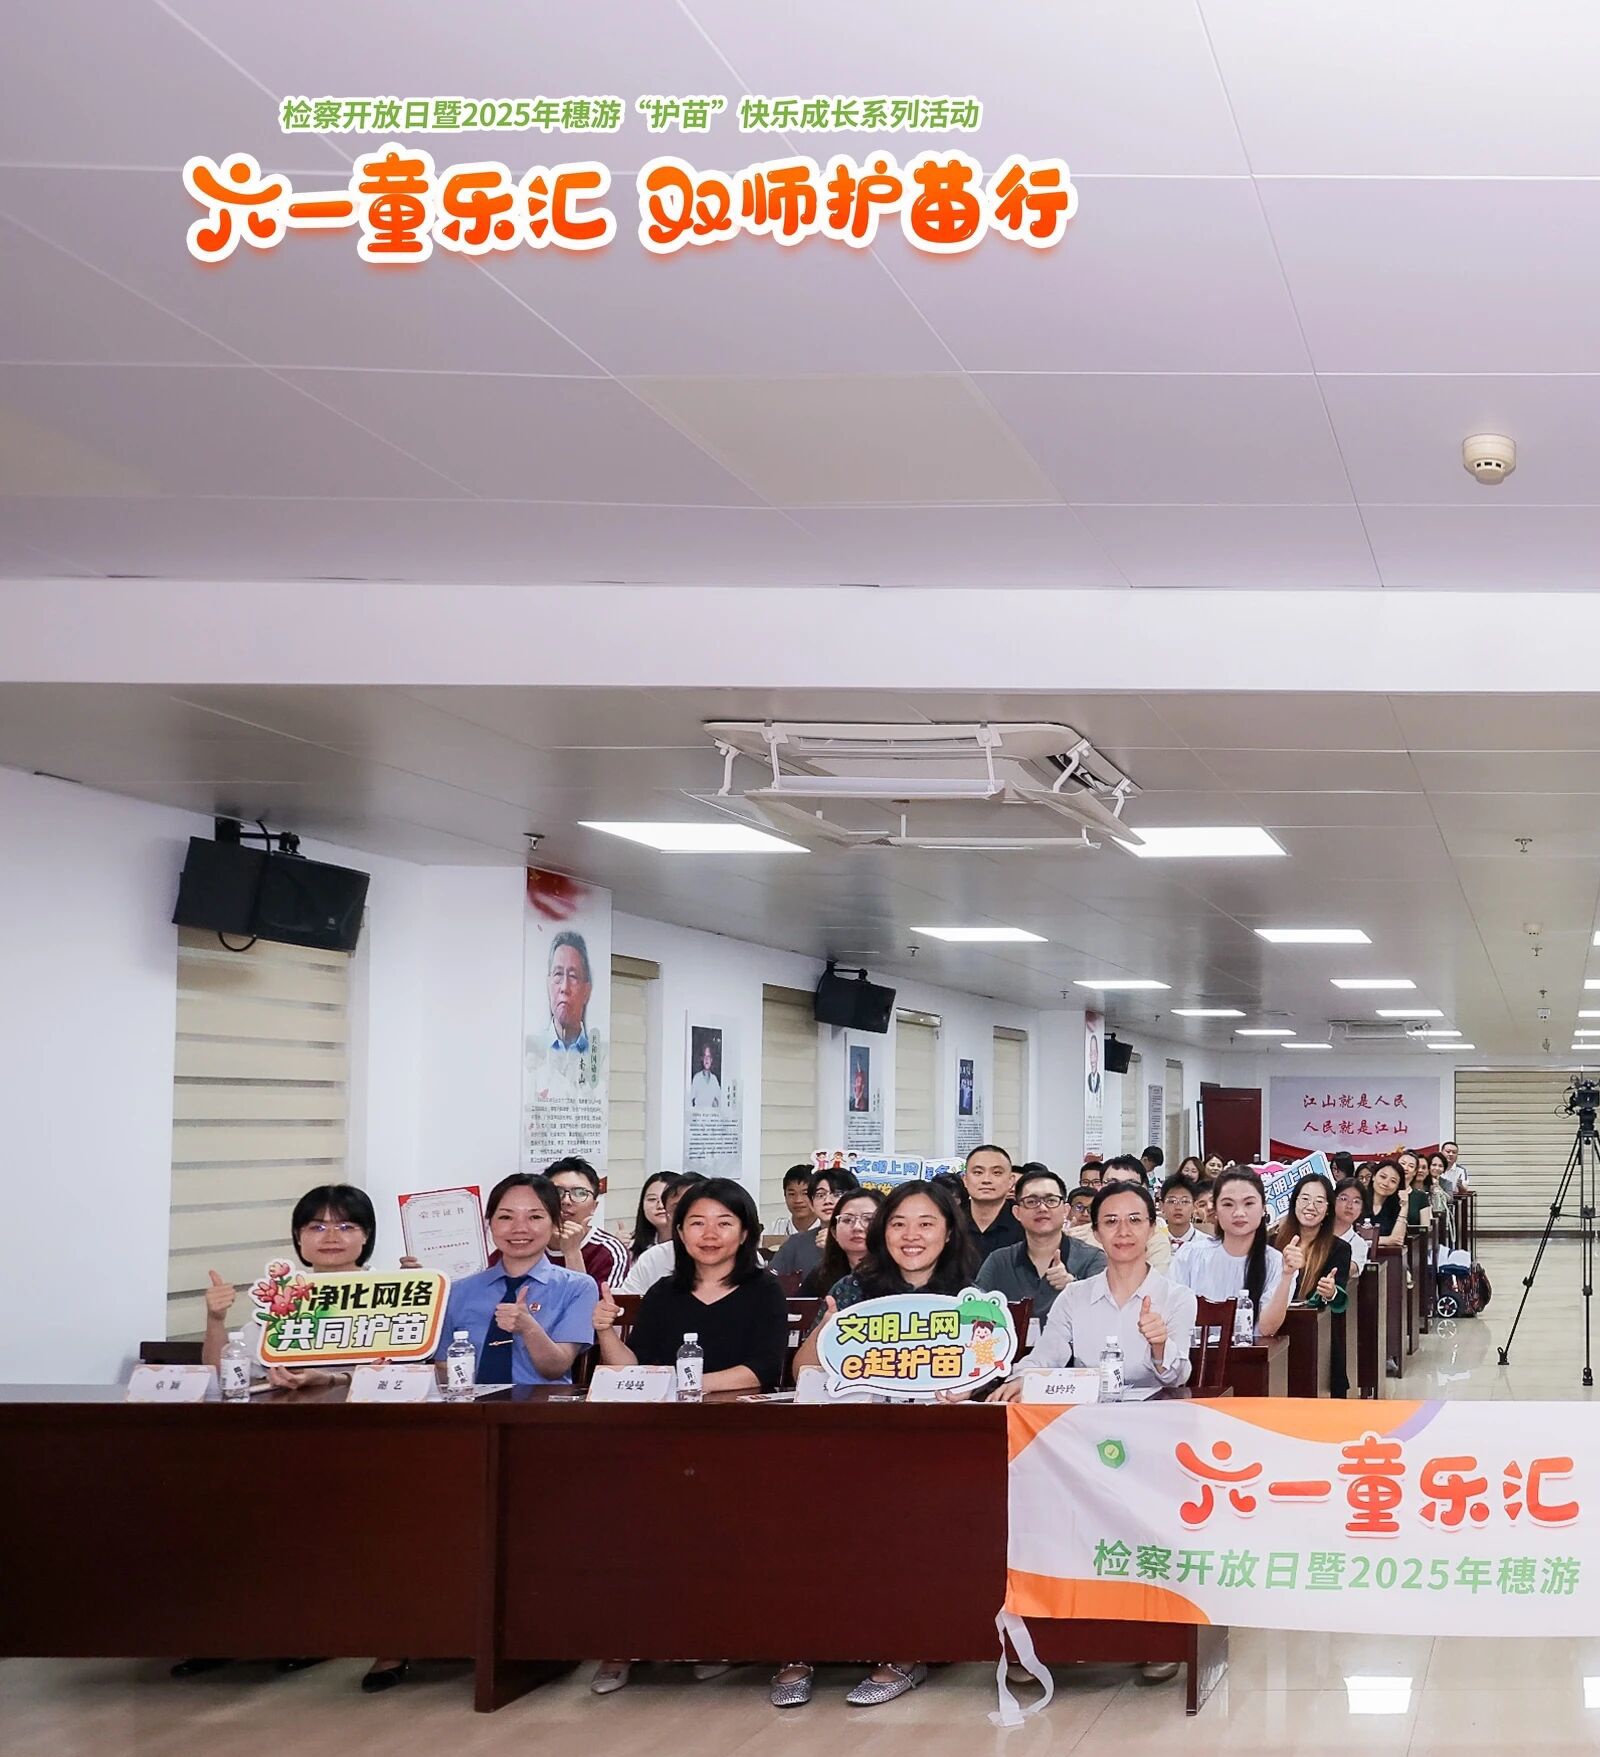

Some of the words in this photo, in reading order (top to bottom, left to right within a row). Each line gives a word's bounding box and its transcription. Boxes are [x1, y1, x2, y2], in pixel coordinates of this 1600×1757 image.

[1303, 1093, 1408, 1109] 江山就是人民
[1303, 1119, 1408, 1135] 人民就是江山
[856, 1158, 920, 1176] 文明上网
[309, 1281, 433, 1312] 净化网络
[276, 1313, 429, 1351] 共同护苗
[837, 1310, 960, 1344] 文明上网
[841, 1345, 964, 1380] e起护苗
[1176, 1438, 1579, 1535] 六一童乐汇
